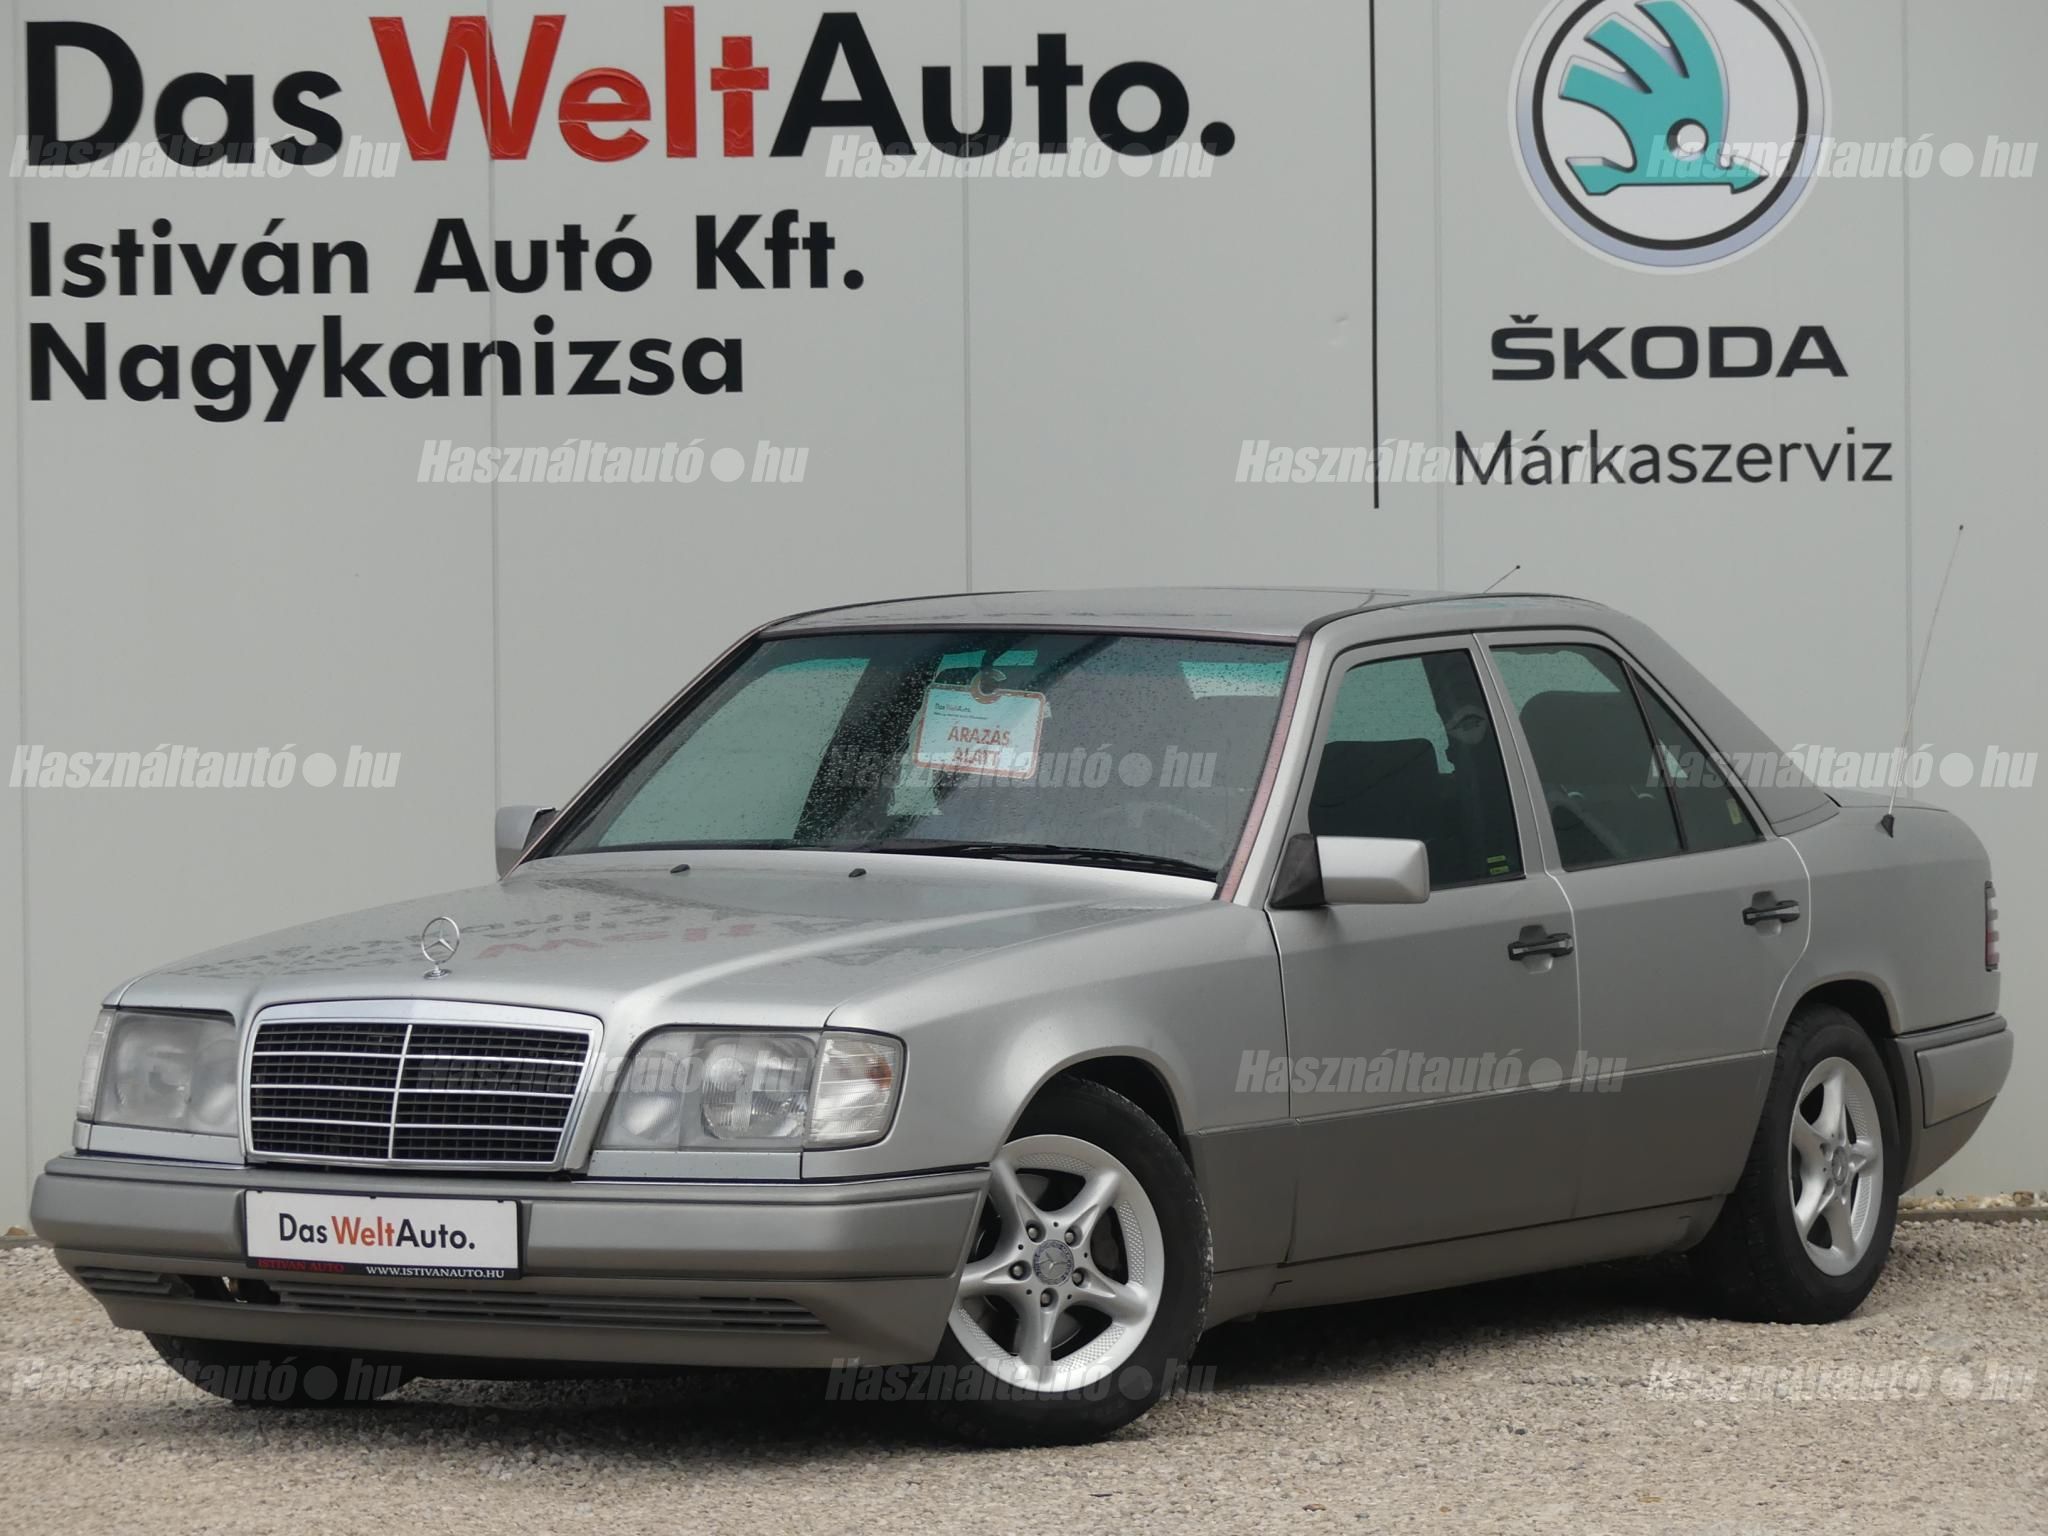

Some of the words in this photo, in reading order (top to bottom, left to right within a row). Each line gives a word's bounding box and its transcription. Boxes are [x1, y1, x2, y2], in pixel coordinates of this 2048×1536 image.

[25, 20, 343, 166] Das
[28, 217, 370, 297] Istiván
[414, 213, 653, 294] Autó
[693, 208, 865, 291] Kft.
[29, 314, 745, 423] Nagykanizsa
[1490, 314, 1849, 381] ŠKODA
[1454, 427, 1893, 485] Márkaszerviz
[947, 720, 1011, 746] ÁRAZÁS
[279, 1213, 328, 1243] Das
[331, 1216, 475, 1250] WeltAuto.
[366, 1265, 505, 1279] WWW.ISTIVANAUTO.HU
